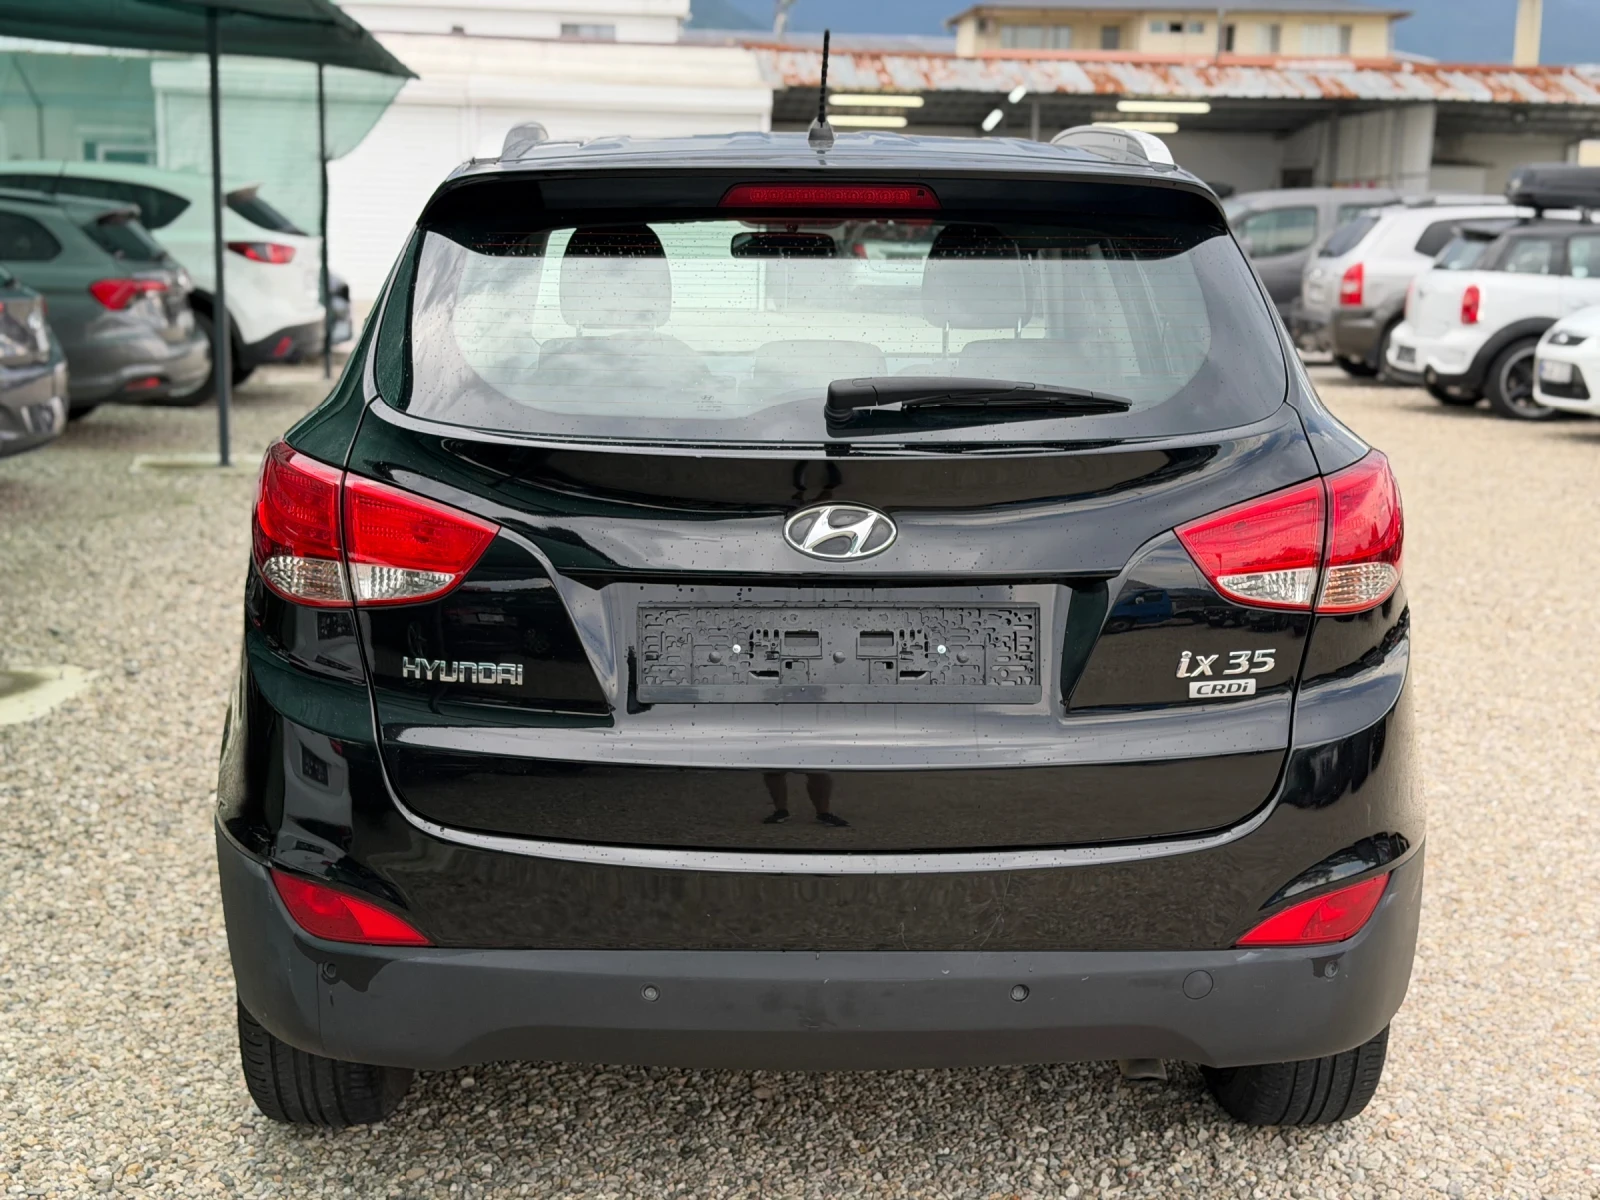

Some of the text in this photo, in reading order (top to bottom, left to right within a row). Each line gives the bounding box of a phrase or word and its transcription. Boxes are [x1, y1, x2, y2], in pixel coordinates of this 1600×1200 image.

[402, 656, 523, 686] HYUNDAI
[1176, 648, 1276, 678] ix 35
[1196, 682, 1249, 695] CRDi
